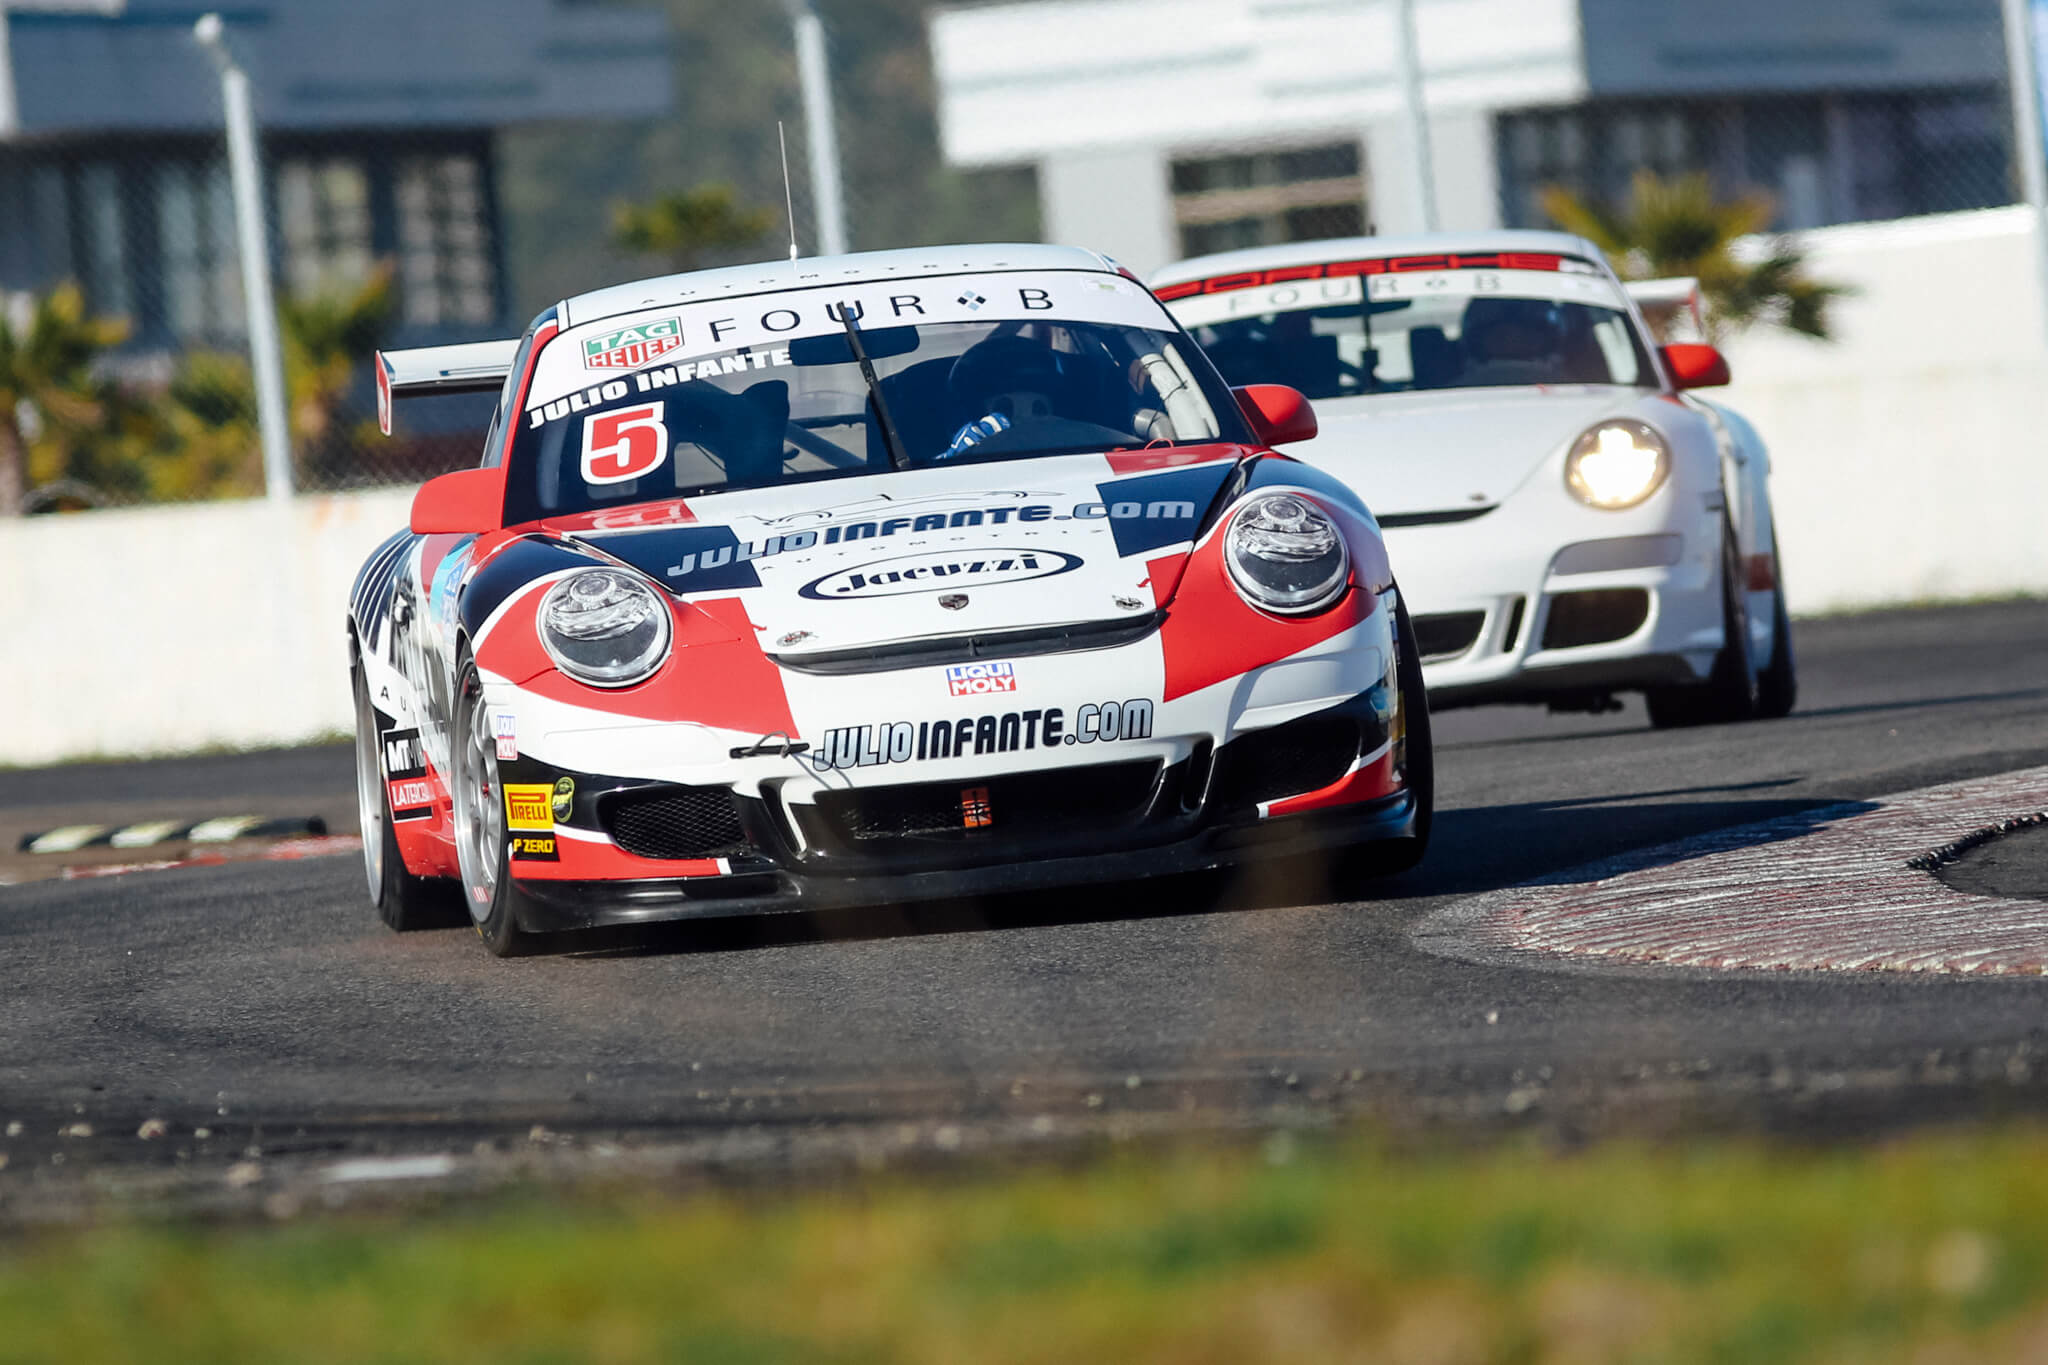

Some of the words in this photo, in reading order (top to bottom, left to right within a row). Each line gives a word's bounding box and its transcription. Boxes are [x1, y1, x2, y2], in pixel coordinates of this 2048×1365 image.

[1228, 277, 1399, 313] FOUR
[1474, 273, 1502, 292] B
[708, 294, 926, 343] FOUR
[1018, 287, 1055, 311] B
[590, 320, 676, 351] TAG
[589, 336, 682, 369] HEUER
[528, 380, 629, 430] JULIO
[636, 348, 794, 392] INFANTE
[582, 402, 666, 483] 5
[836, 553, 1042, 594] Jacuzzi
[950, 662, 1012, 681] LIQUI
[951, 677, 1017, 695] MOLY
[508, 792, 548, 821] PIRELLI
[513, 839, 522, 853] P
[523, 839, 554, 853] ZERO
